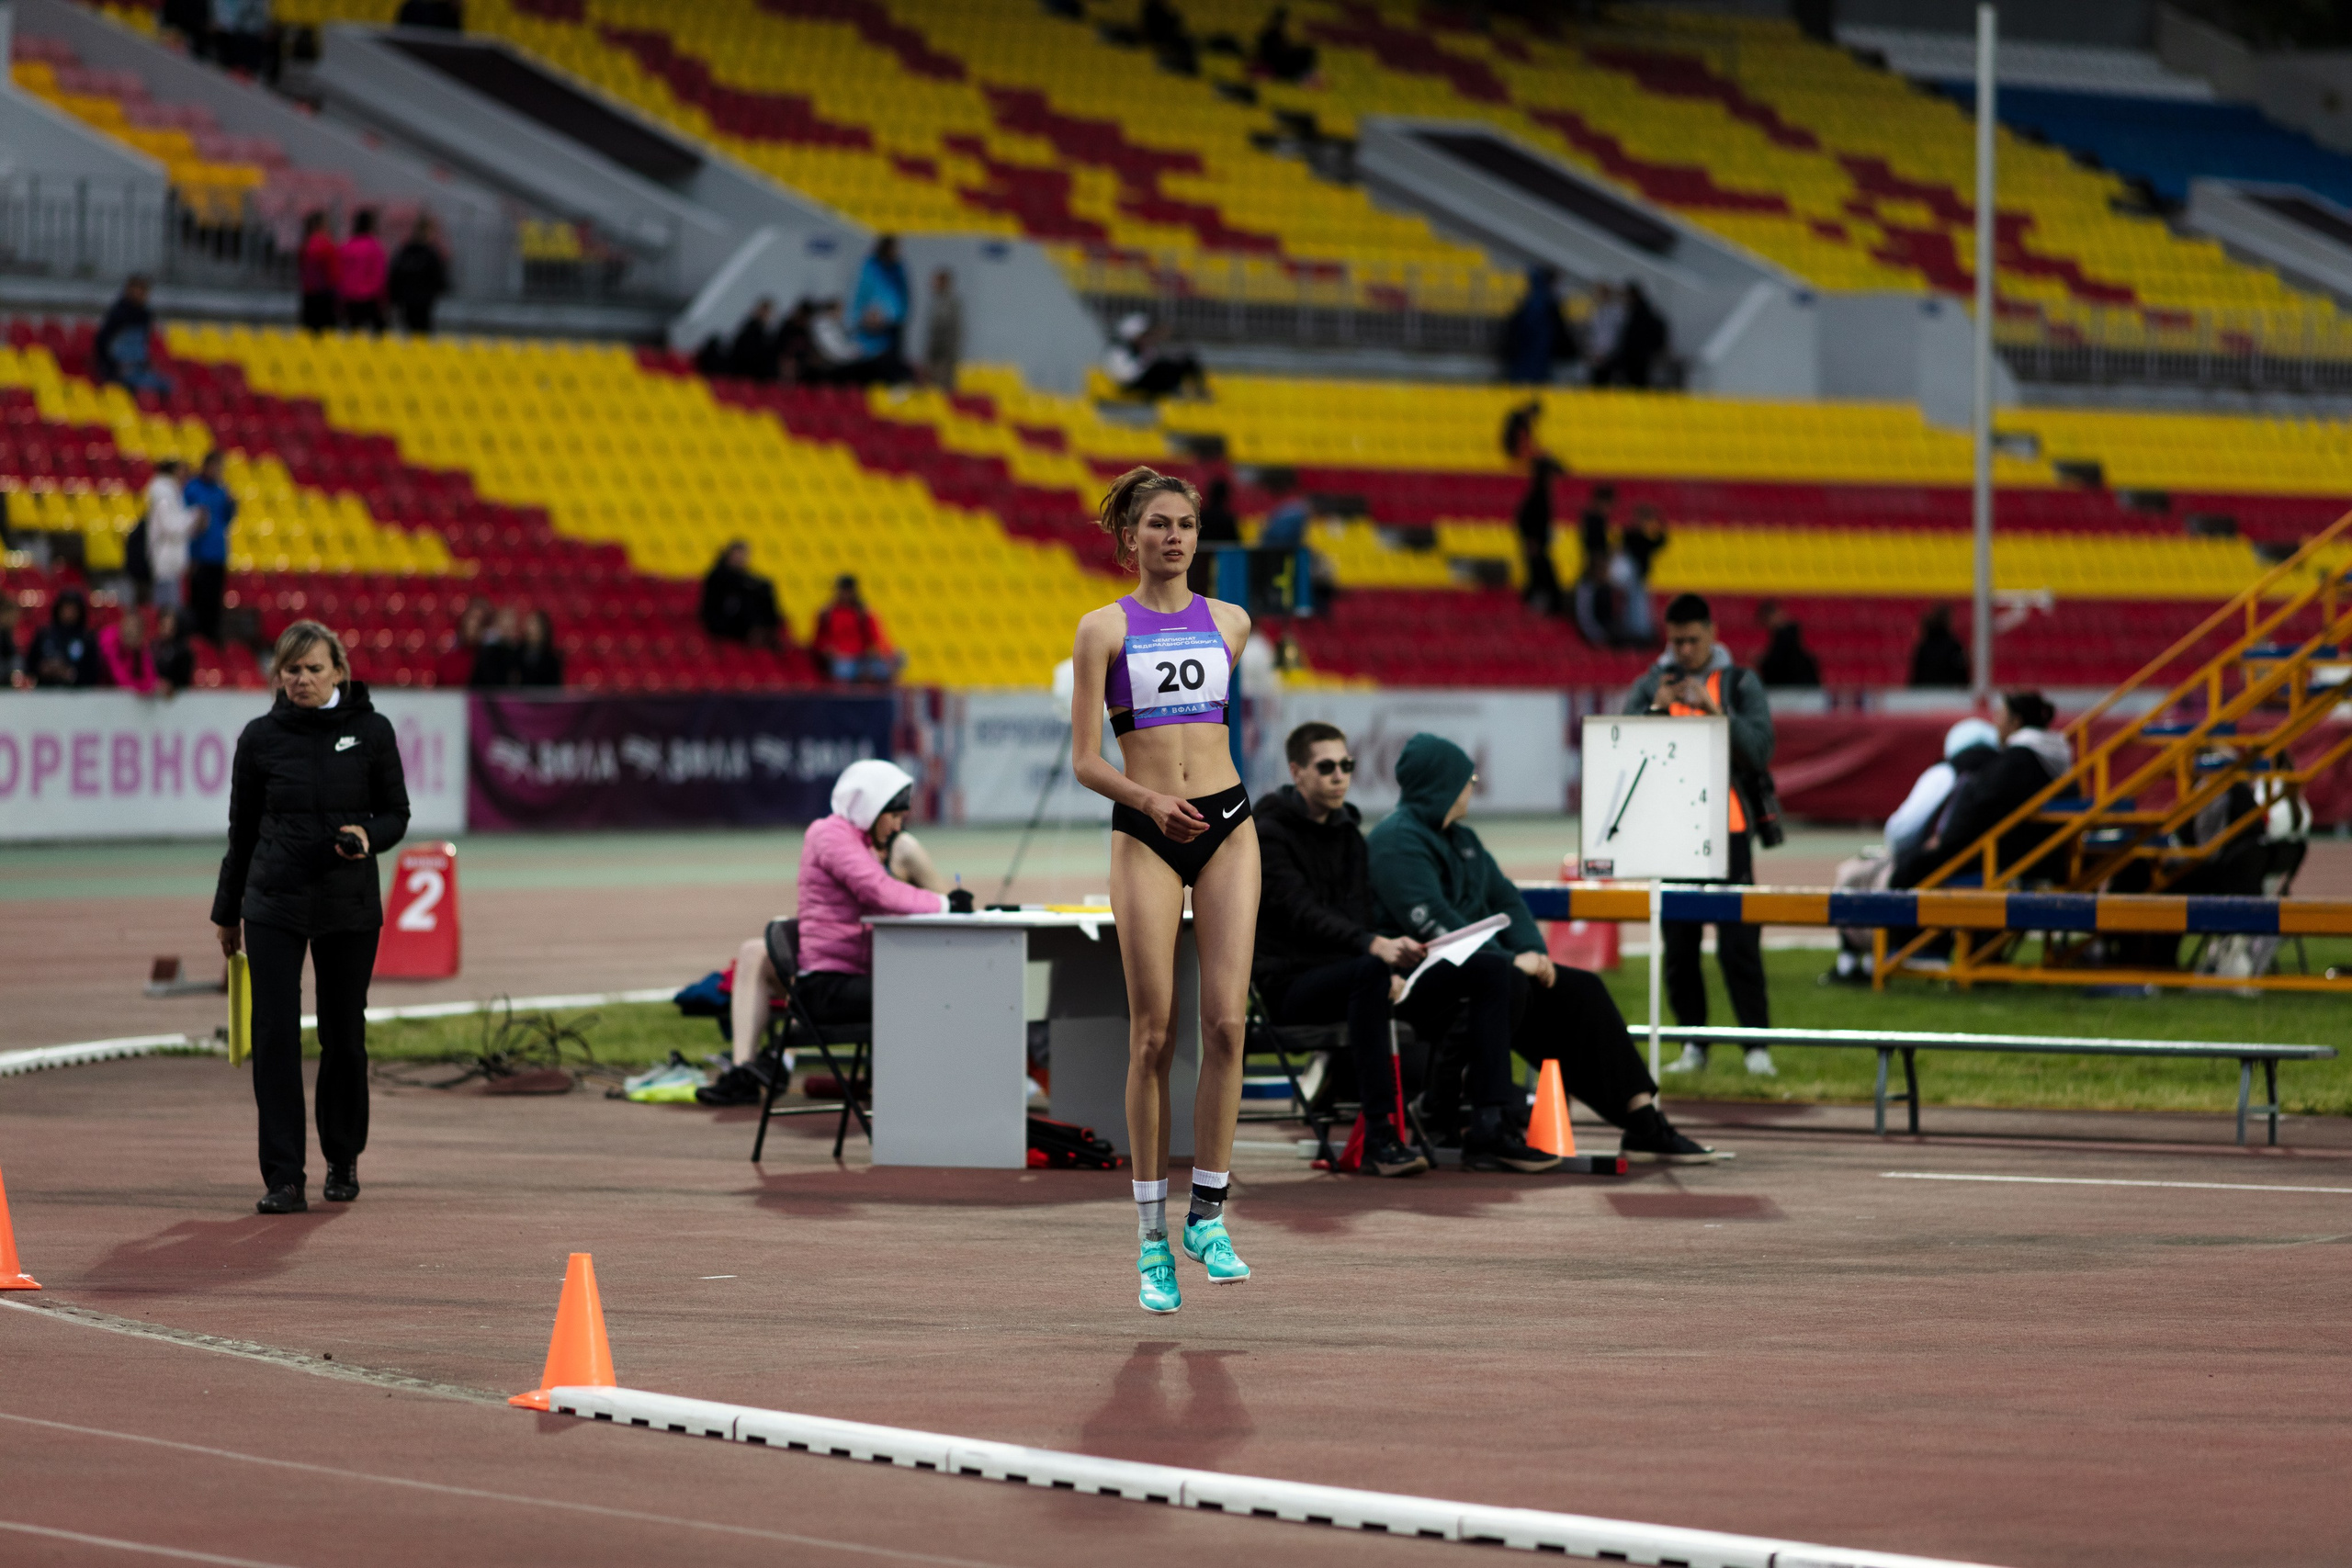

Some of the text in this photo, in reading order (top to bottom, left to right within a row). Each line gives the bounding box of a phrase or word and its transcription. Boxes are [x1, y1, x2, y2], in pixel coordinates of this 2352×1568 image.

[1132, 640, 1191, 649] ФЕДЕРАЛЬНОГО
[1155, 659, 1205, 694] 20
[1171, 705, 1198, 714] ВФЛА
[1611, 725, 1620, 742] 0
[1668, 742, 1677, 759] 2
[1699, 788, 1707, 804] 4
[1702, 840, 1712, 856] 6
[397, 870, 446, 932] 2
